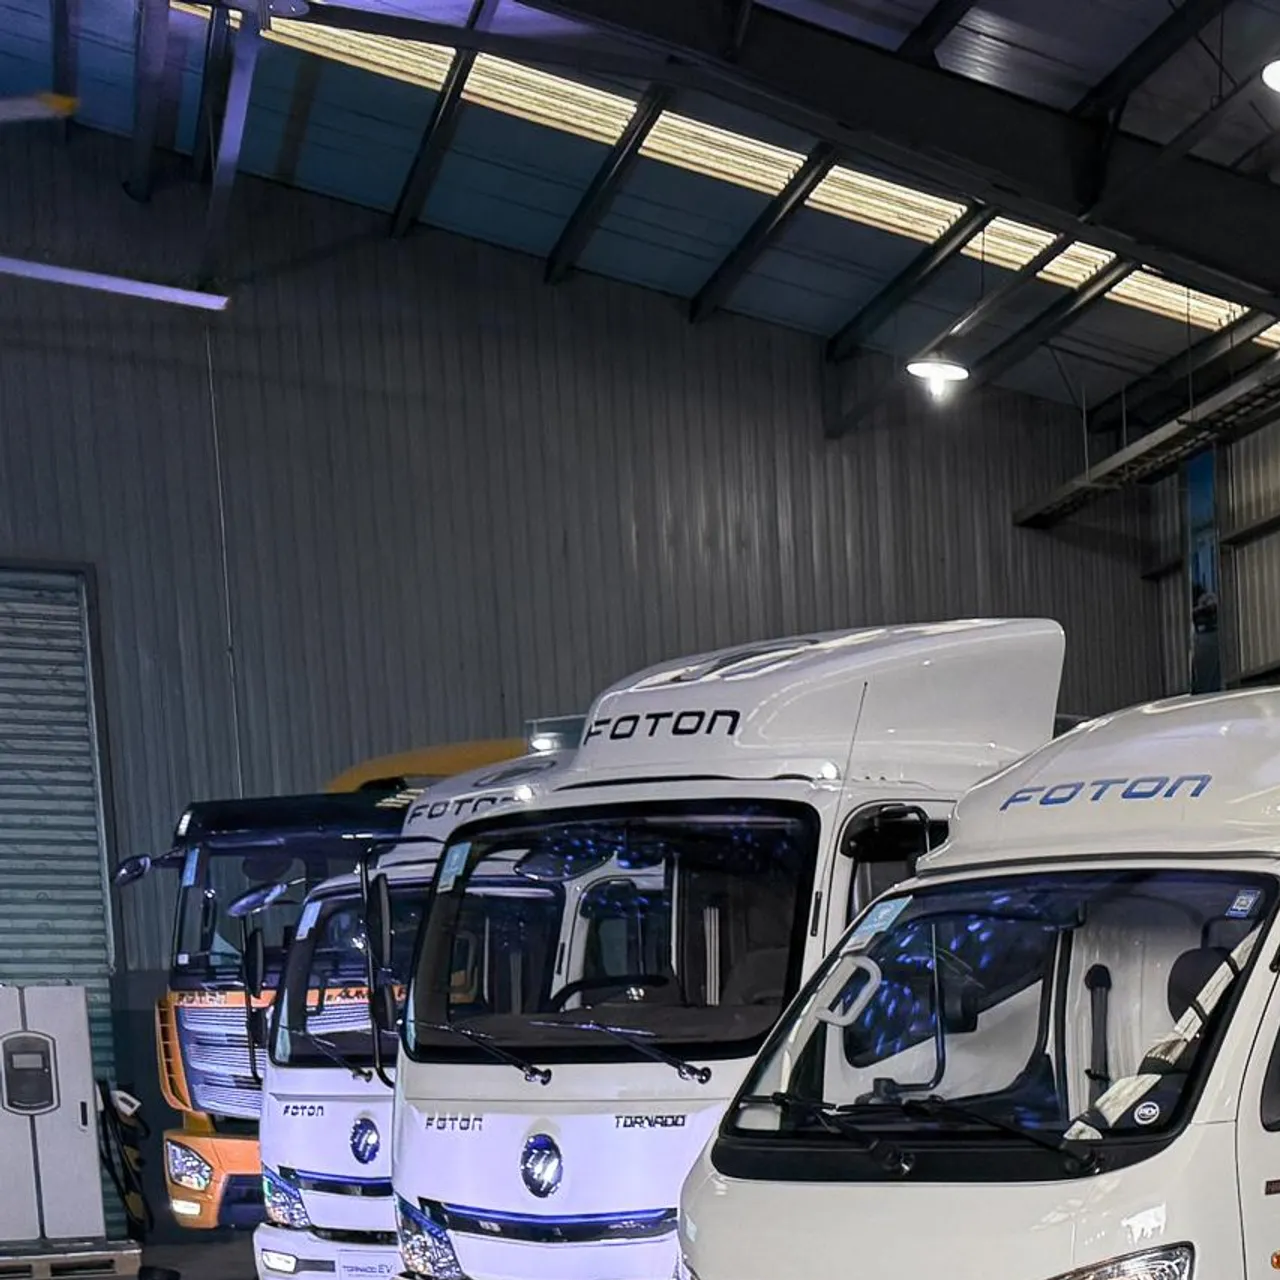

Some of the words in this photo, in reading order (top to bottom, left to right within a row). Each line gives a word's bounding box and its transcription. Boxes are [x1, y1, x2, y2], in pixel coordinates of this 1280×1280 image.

[582, 709, 741, 746] FOTON
[999, 774, 1213, 812] FOTON
[283, 1105, 324, 1117] FOTON
[425, 1115, 483, 1131] FOTON
[615, 1114, 687, 1129] TORNADO
